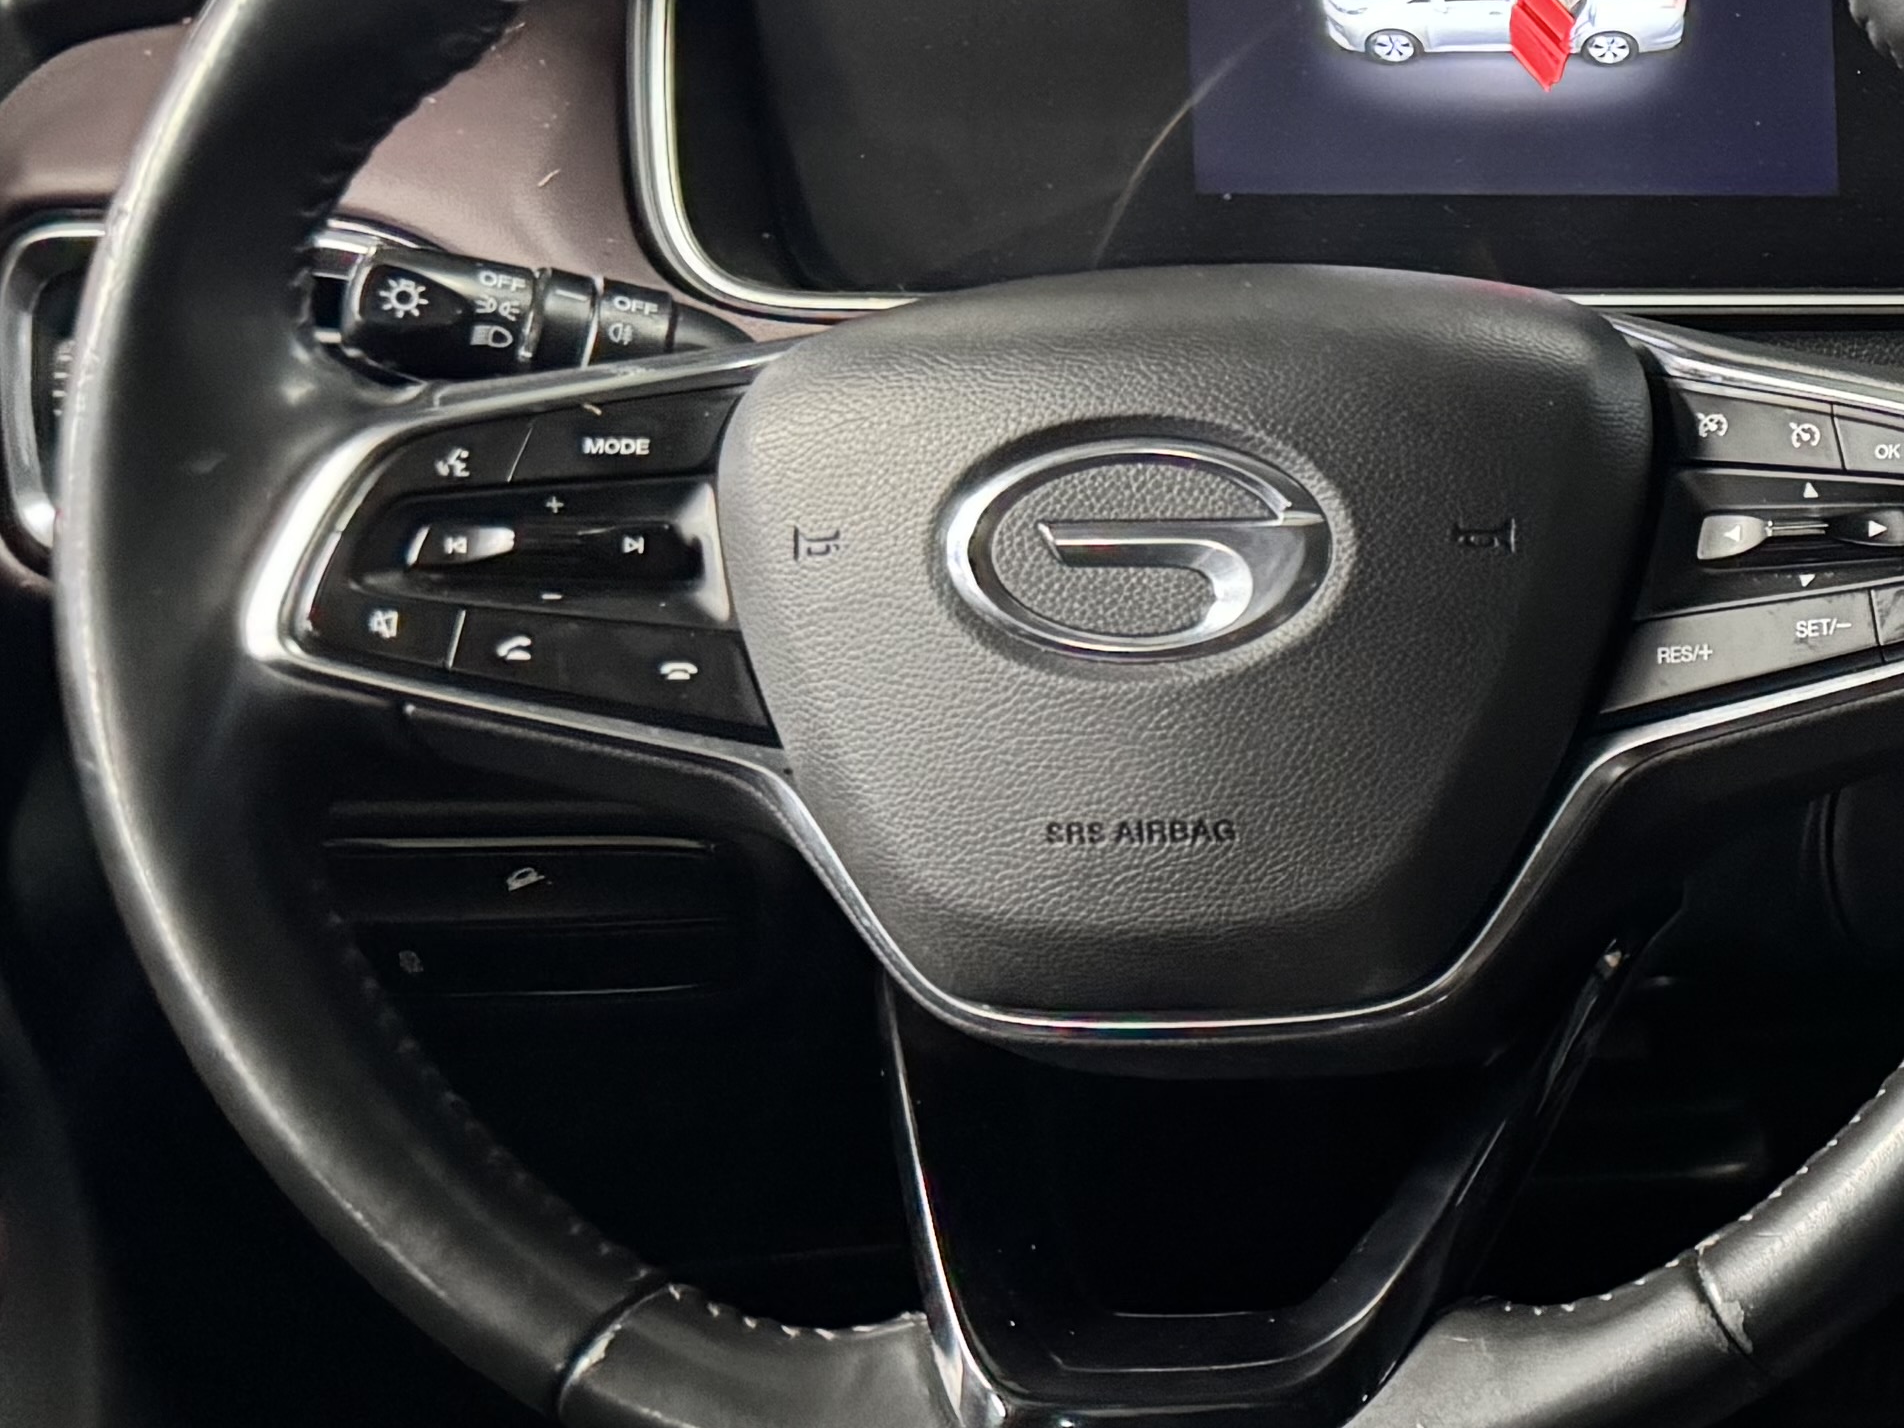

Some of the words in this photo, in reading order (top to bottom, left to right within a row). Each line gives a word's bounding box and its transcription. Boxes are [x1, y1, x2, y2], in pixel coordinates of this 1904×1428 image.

[477, 270, 527, 292] OFF
[613, 295, 659, 316] OFF
[583, 436, 650, 457] MODE
[1874, 443, 1902, 460] OK
[1657, 643, 1714, 665] RES/+
[1045, 821, 1104, 845] SRS
[1115, 818, 1236, 845] AIRBAG
